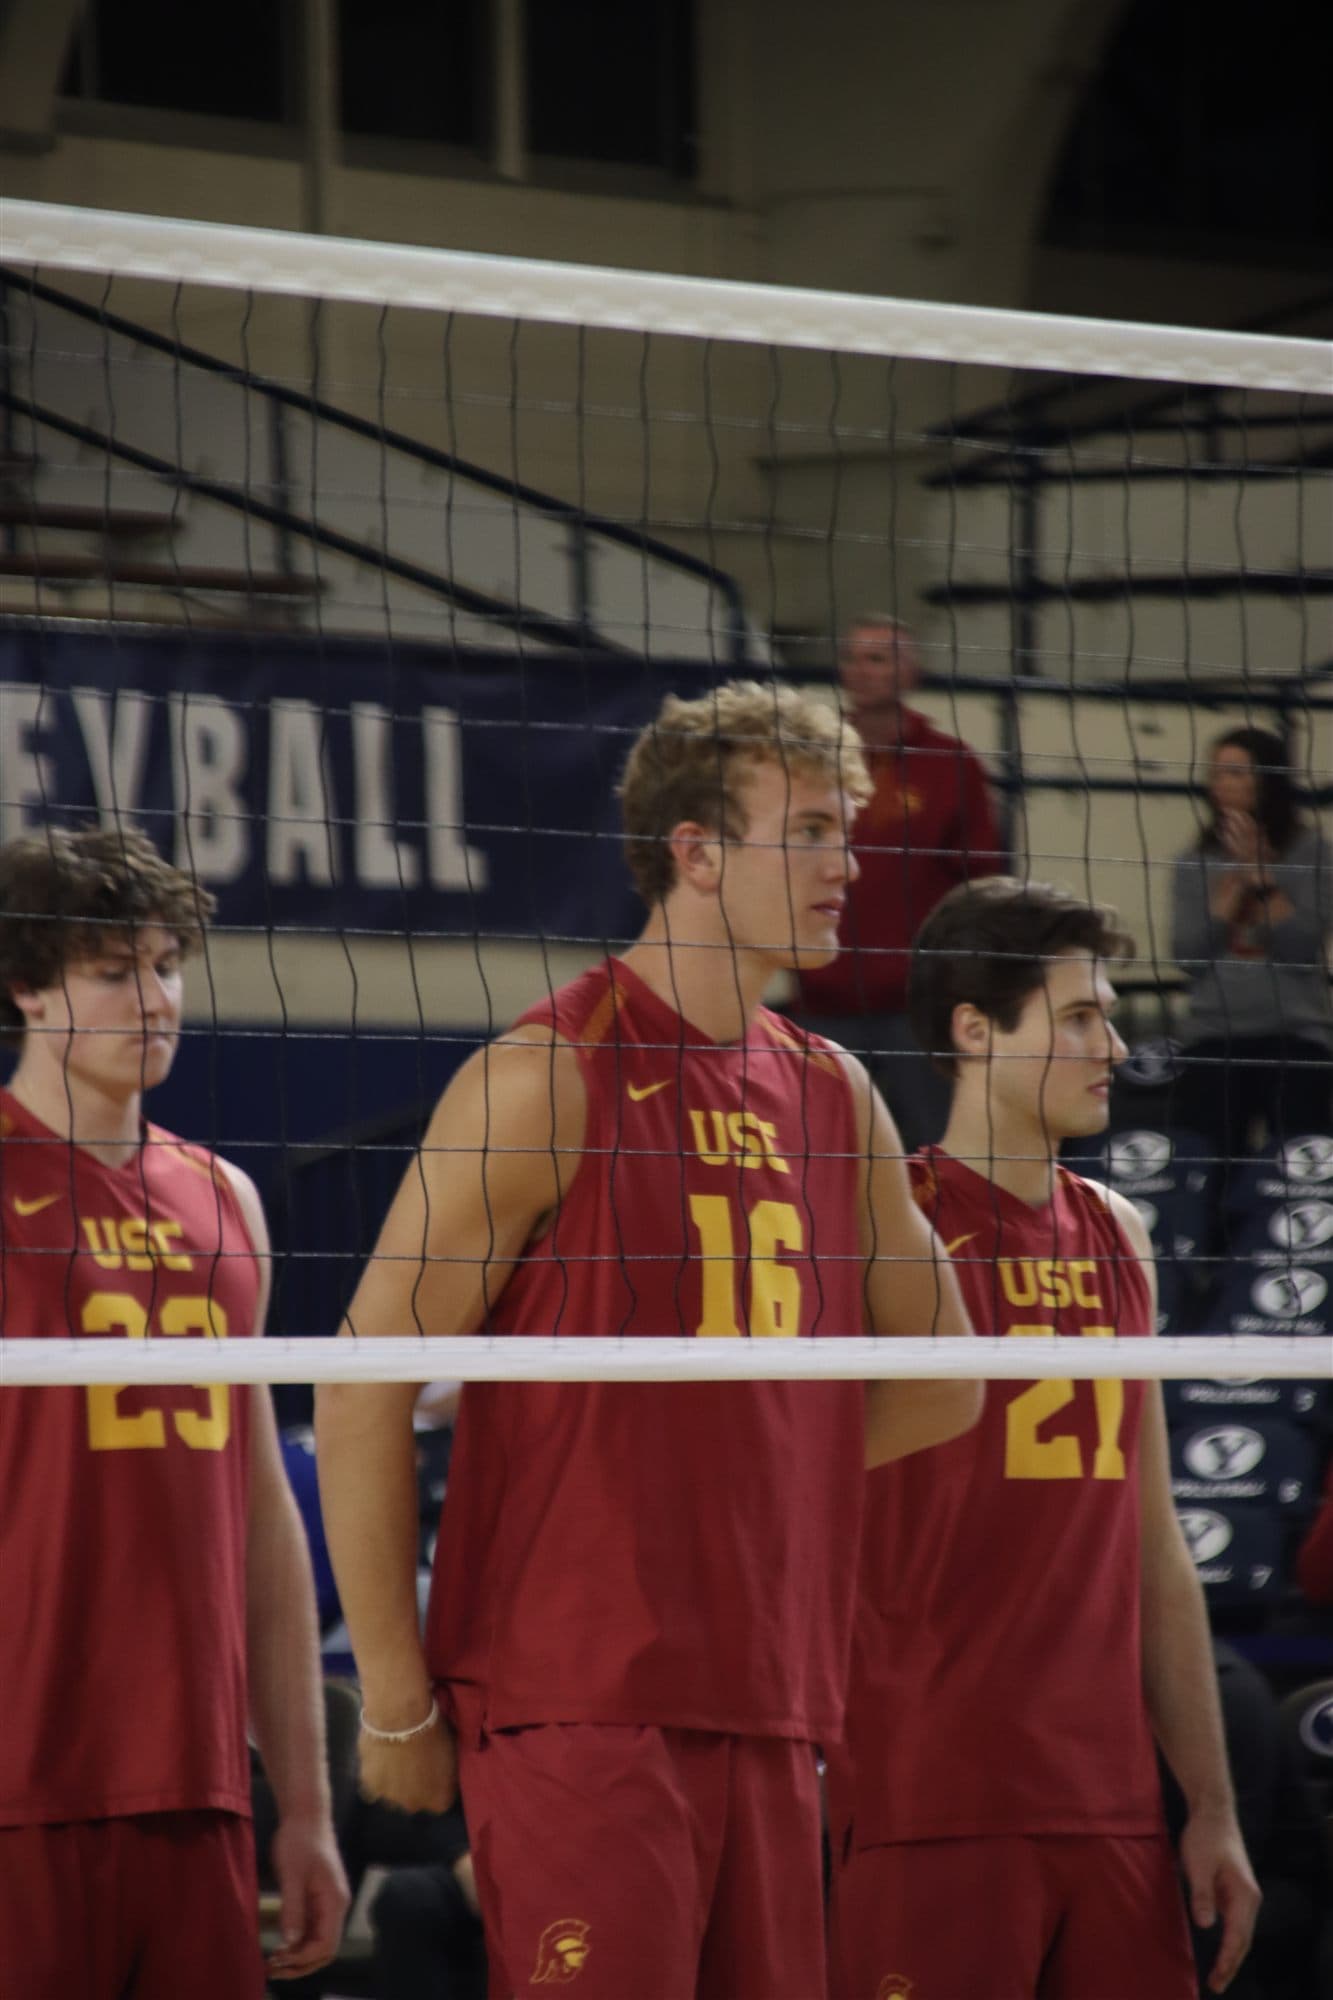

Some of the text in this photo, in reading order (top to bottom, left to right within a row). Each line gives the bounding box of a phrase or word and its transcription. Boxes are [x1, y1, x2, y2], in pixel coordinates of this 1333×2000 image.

[0, 682, 487, 891] EYBALL
[688, 1110, 790, 1174] USC
[81, 1216, 193, 1271] USC
[688, 1194, 803, 1338] 16
[996, 1256, 1103, 1310] USC
[81, 1292, 230, 1450] 23
[1004, 1324, 1125, 1481] 21
